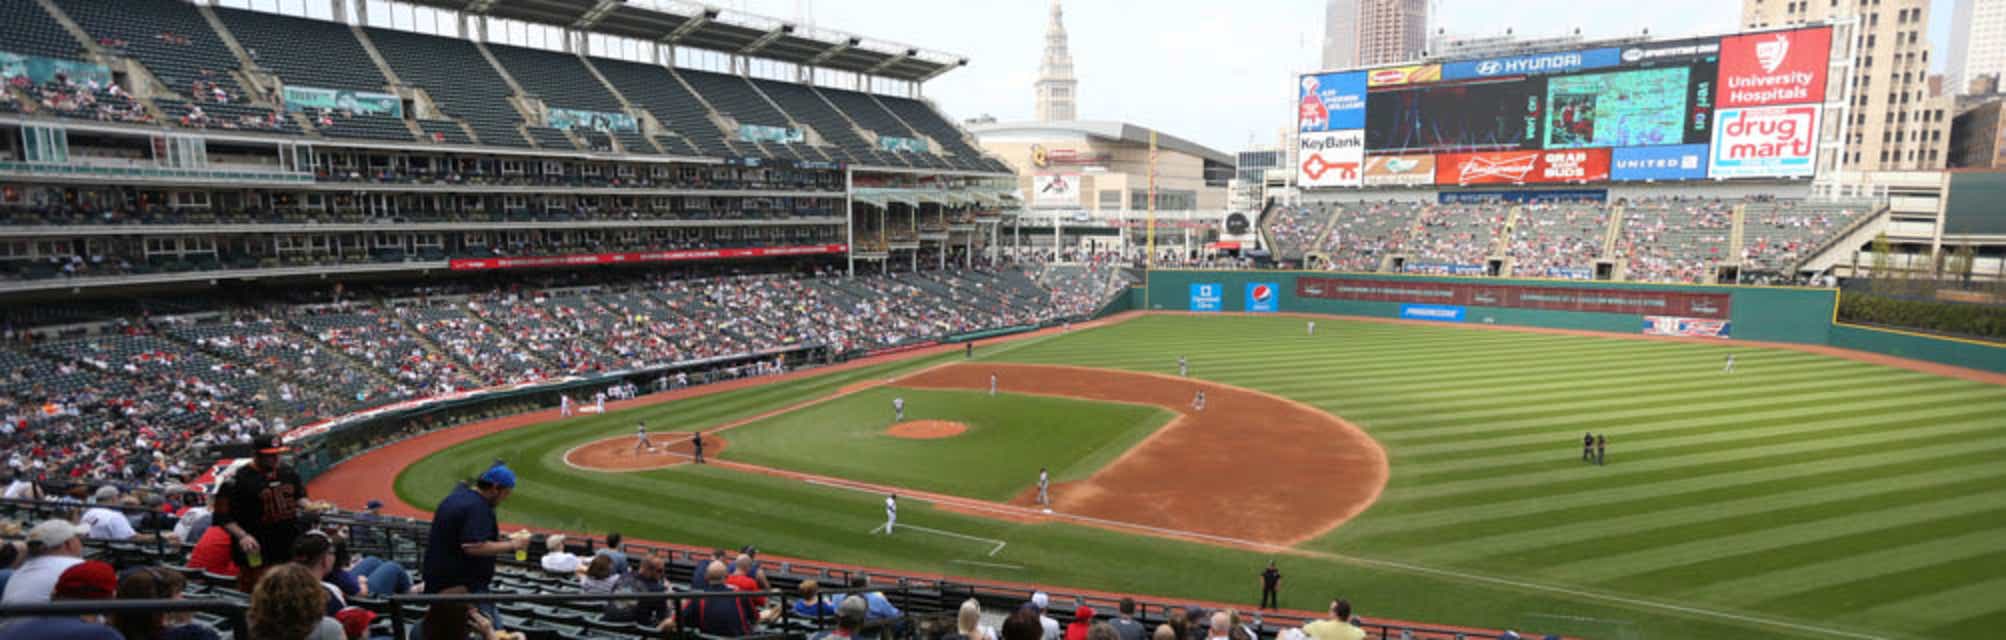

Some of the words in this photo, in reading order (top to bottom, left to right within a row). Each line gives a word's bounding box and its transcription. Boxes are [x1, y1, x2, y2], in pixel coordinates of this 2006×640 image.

[1505, 54, 1581, 71] HYUNDAI
[1727, 70, 1813, 89] University
[1730, 86, 1809, 103] Hospitals
[1726, 109, 1797, 141] drug
[1301, 136, 1361, 150] KeyBank
[1729, 138, 1808, 158] mart
[1617, 159, 1678, 168] UNITED
